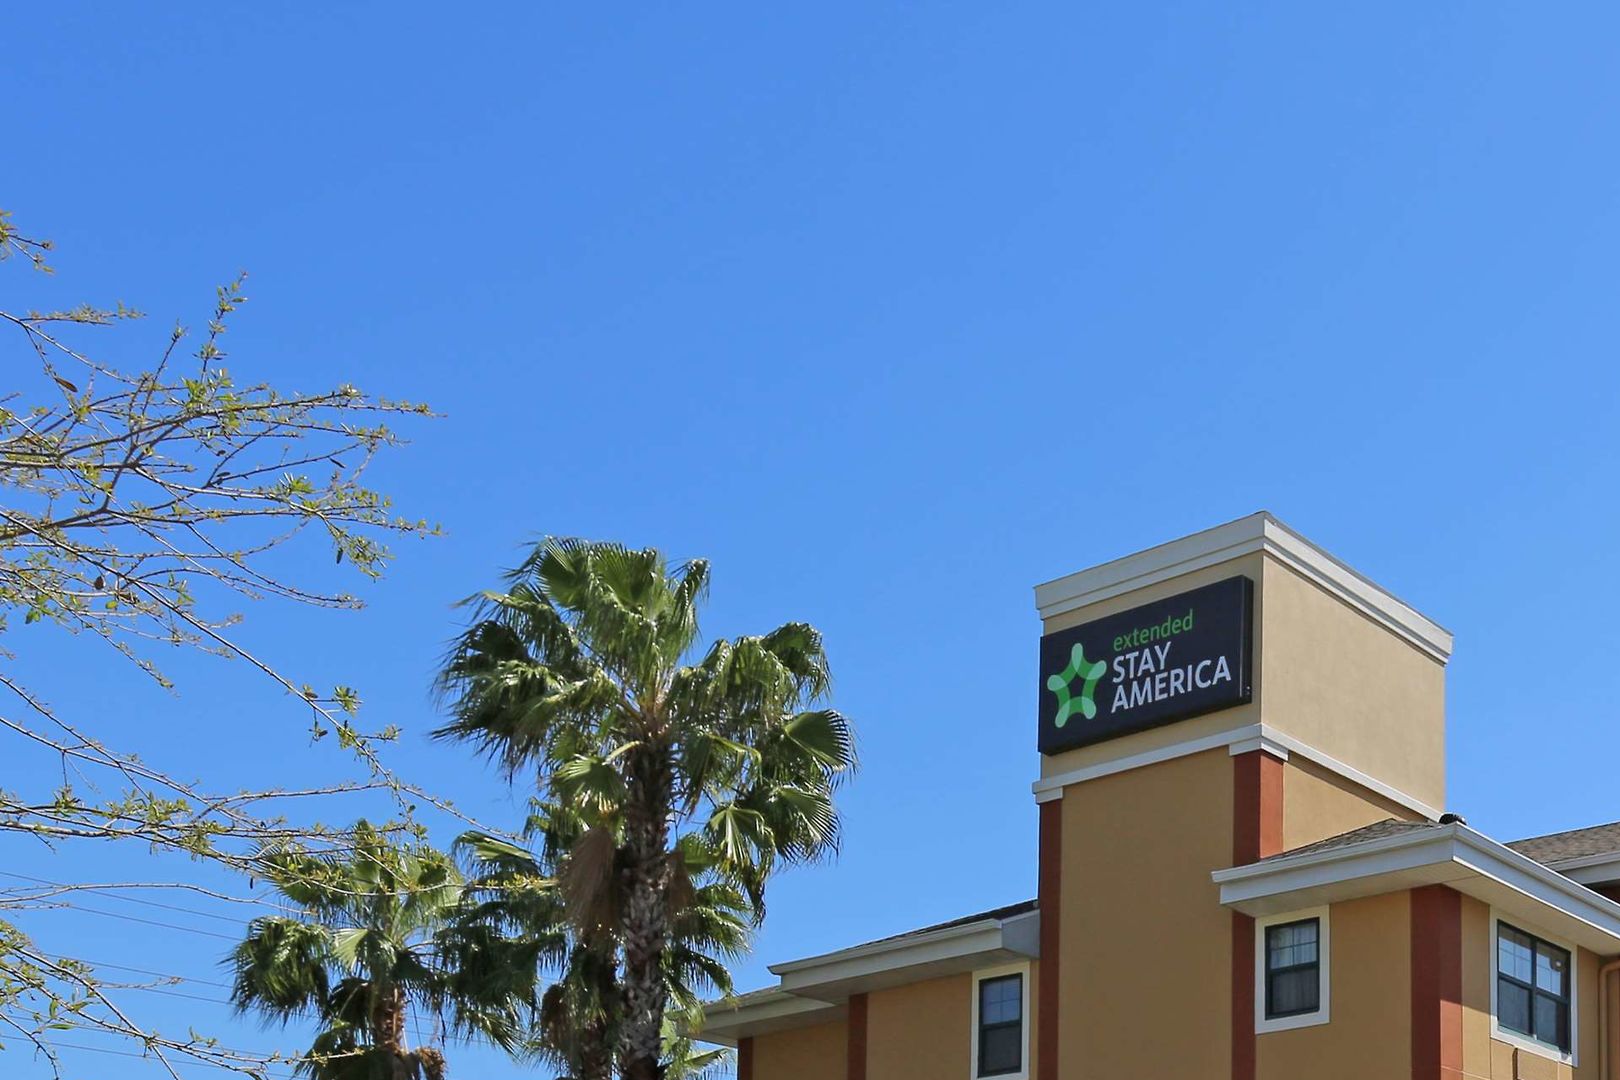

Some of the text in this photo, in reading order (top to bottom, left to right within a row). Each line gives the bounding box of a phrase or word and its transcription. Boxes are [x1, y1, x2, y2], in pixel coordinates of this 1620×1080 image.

[1113, 609, 1193, 651] extended
[1112, 641, 1172, 684] STAY
[1111, 656, 1232, 713] AMERICA
